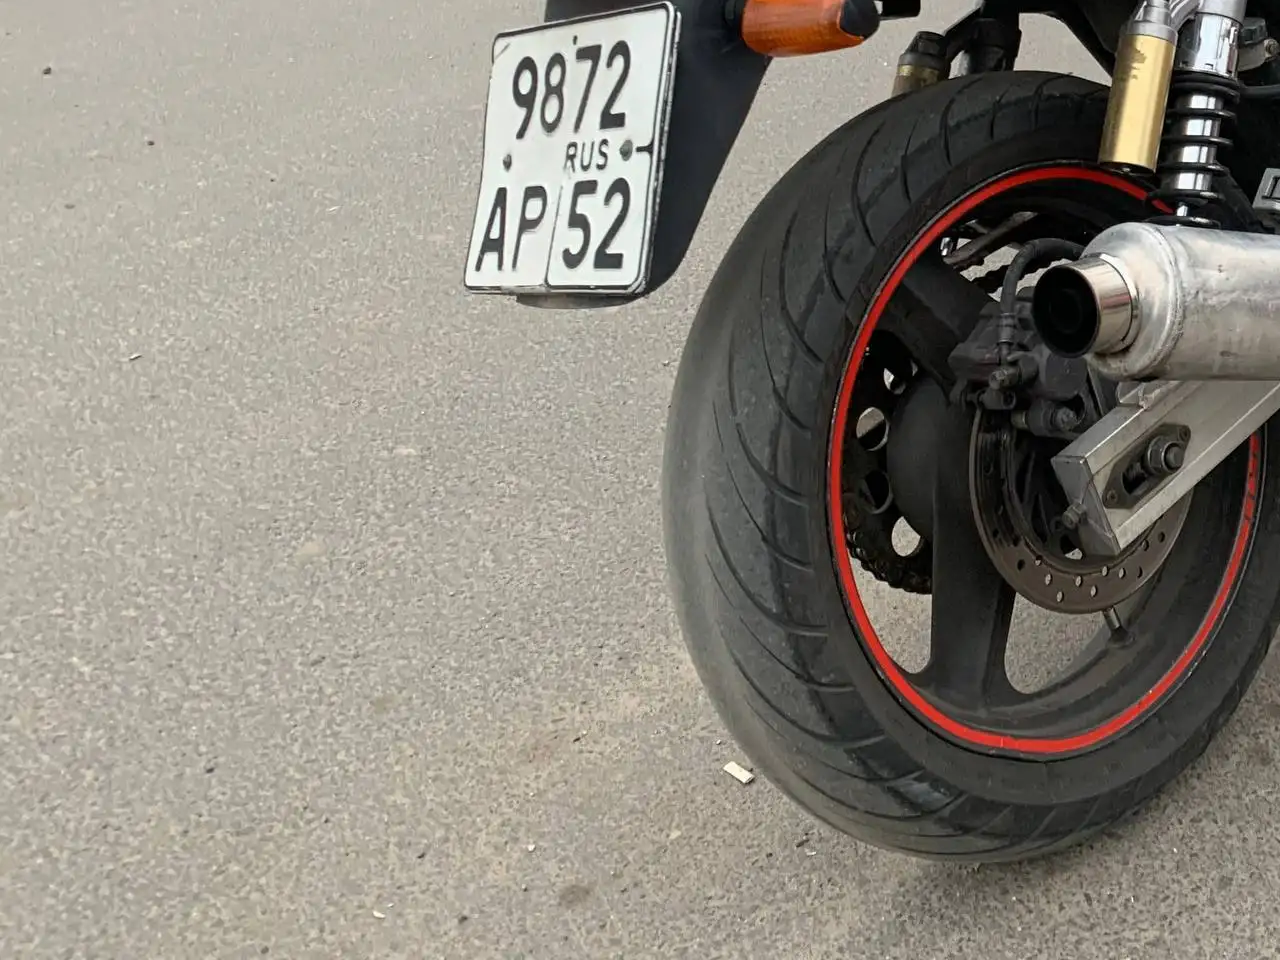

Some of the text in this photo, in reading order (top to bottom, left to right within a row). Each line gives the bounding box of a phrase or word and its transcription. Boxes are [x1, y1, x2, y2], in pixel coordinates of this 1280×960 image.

[512, 40, 632, 140] 9872
[565, 138, 609, 173] RUS
[562, 177, 631, 270] 52
